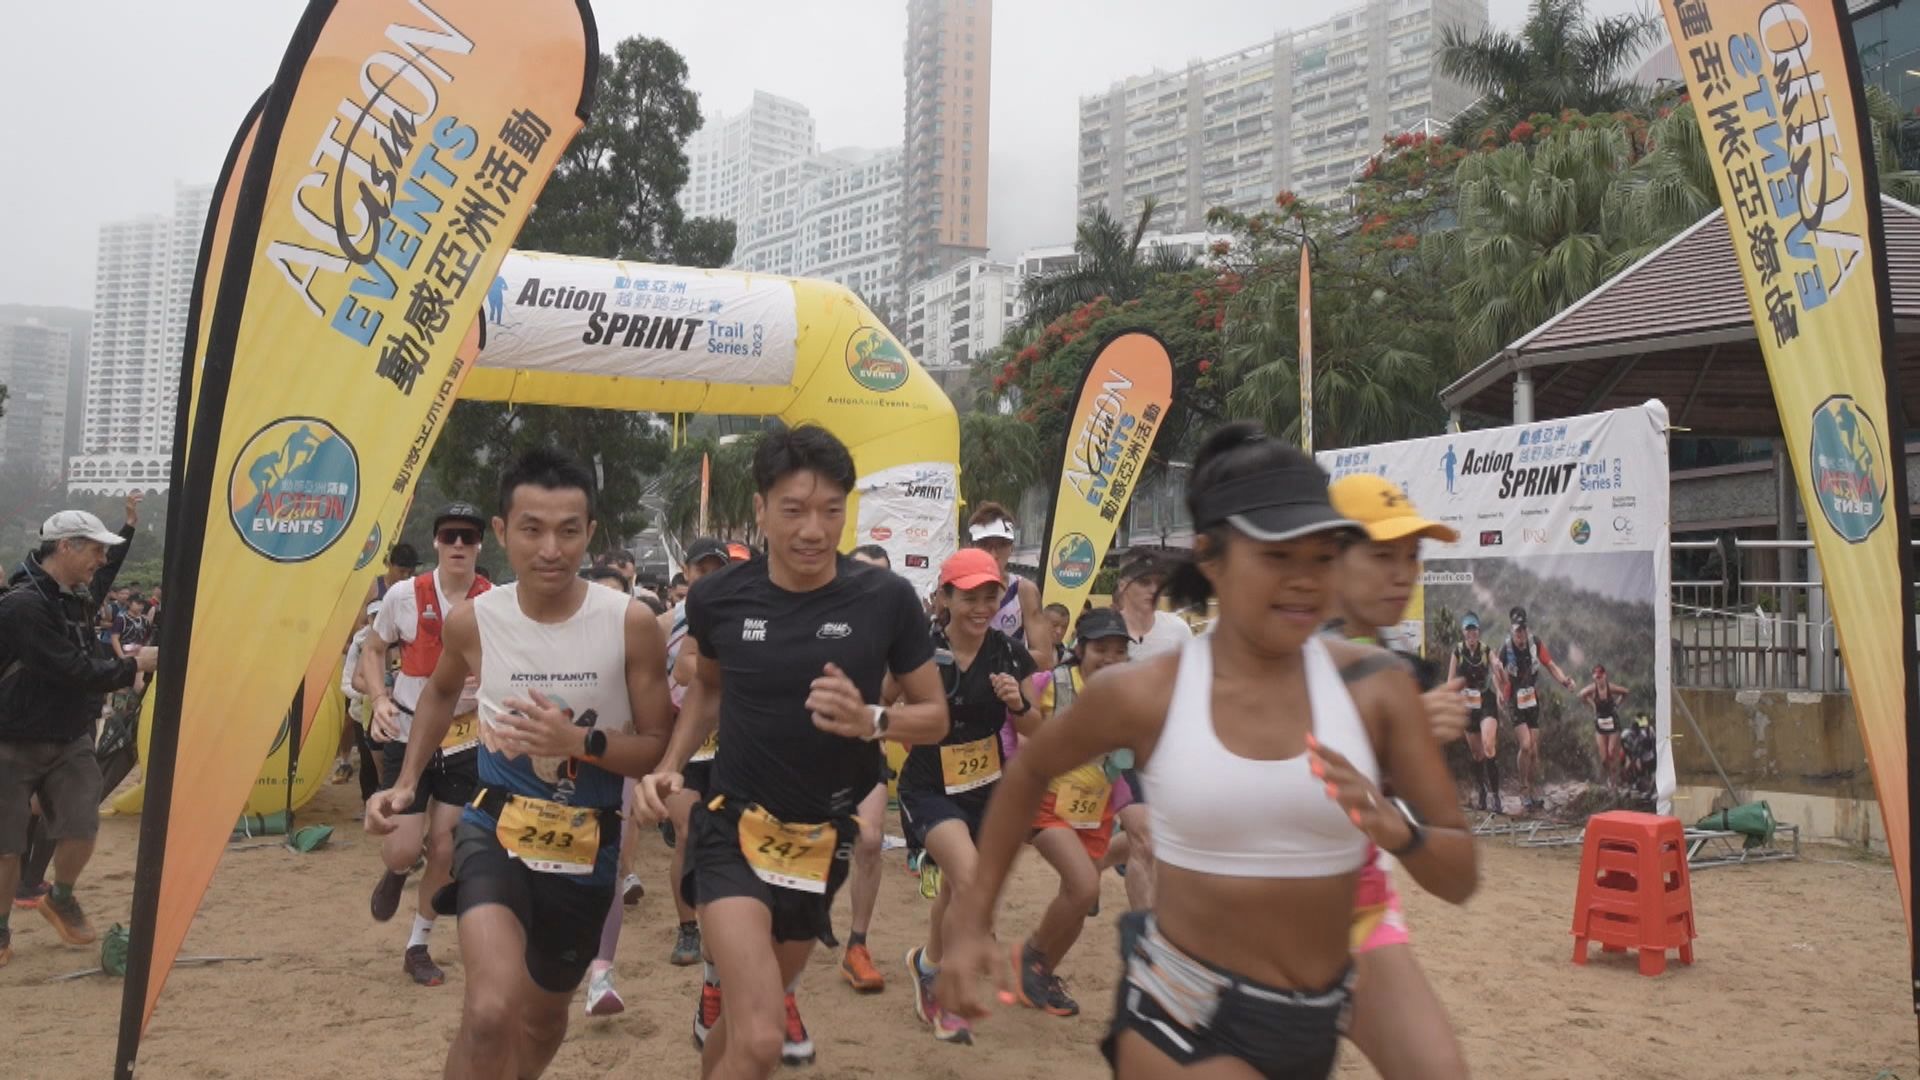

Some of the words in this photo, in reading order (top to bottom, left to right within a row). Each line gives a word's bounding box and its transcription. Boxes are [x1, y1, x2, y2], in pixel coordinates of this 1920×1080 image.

[266, 0, 475, 316] ACTION
[330, 115, 479, 348] EVENTS
[376, 107, 552, 396] 動感亞洲活動
[516, 277, 606, 313] Action
[614, 276, 686, 294] 動感亞洲
[582, 312, 704, 352] SPRINT
[708, 319, 744, 339] Trail
[752, 323, 763, 357] 2023
[708, 338, 749, 356] Series
[1065, 368, 1134, 498] ACTION
[1087, 411, 1138, 508] EVENTS
[1100, 403, 1161, 523] 動感亞洲活動
[1461, 448, 1514, 476] Action
[1580, 459, 1606, 475] Trail
[904, 484, 943, 500] SPRINT
[1499, 462, 1578, 499] SPRINT
[1579, 476, 1611, 491] Series
[255, 491, 348, 521] ACTION
[252, 517, 323, 535] EVENTS
[510, 673, 547, 681] ACTION
[550, 672, 598, 681] PEANUTS
[957, 756, 989, 775] 292
[1068, 800, 1096, 814] 350
[518, 826, 574, 848] 243
[757, 835, 813, 859] 247
